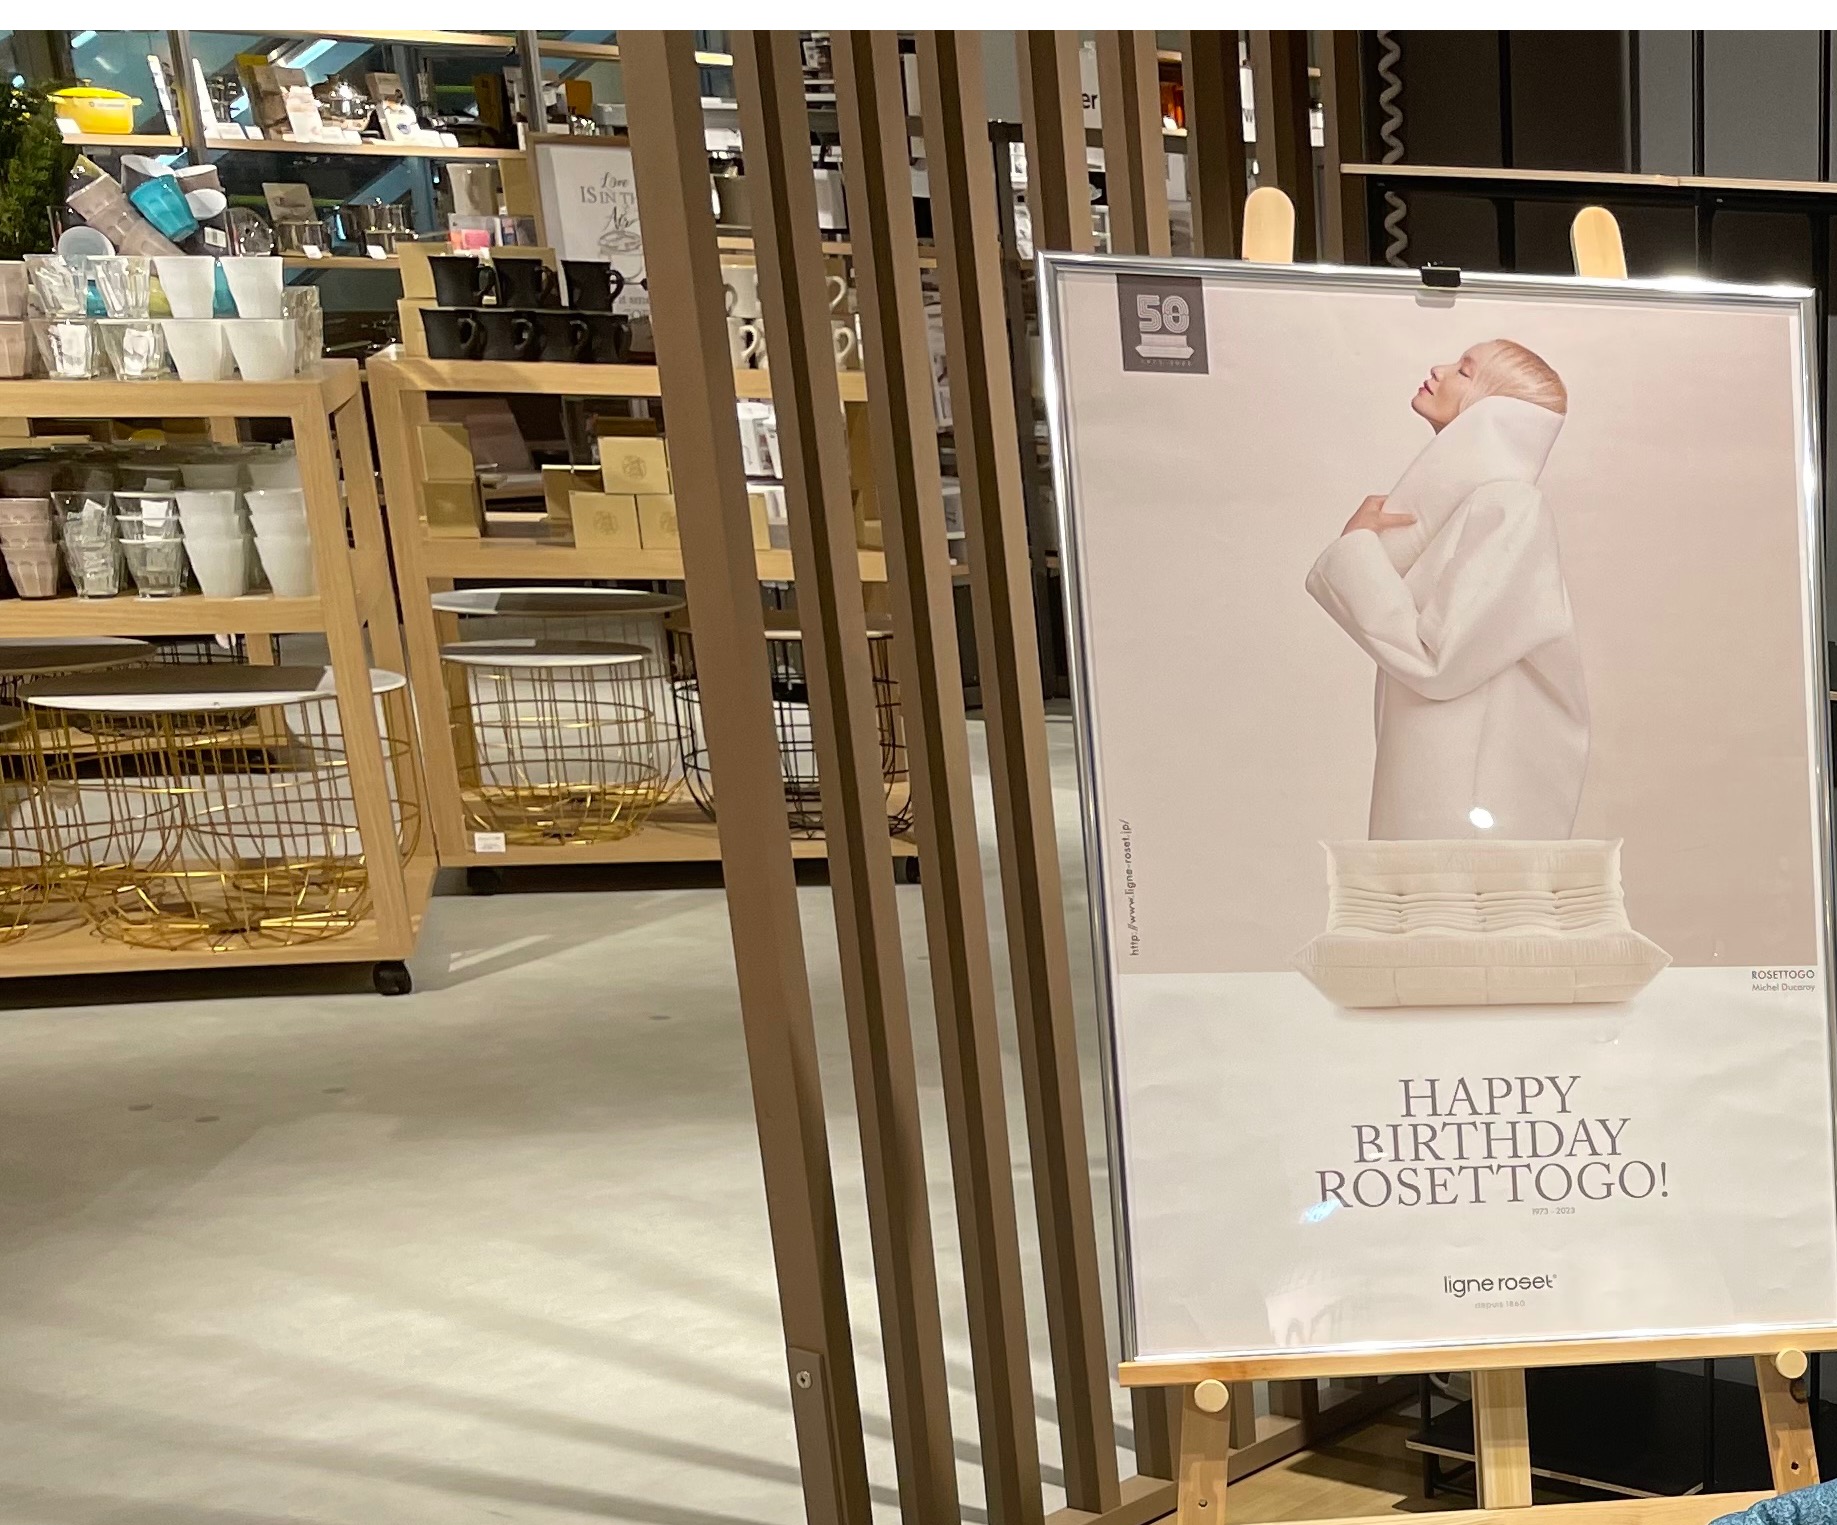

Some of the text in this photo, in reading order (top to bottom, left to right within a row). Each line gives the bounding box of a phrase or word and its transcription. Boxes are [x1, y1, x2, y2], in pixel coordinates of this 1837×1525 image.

[580, 186, 598, 204] IS
[600, 191, 617, 204] IN
[1136, 294, 1190, 333] 50
[1119, 818, 1140, 956] http://www.ligne-roset.jp/
[1751, 969, 1815, 979] ROSETTOGO
[1752, 983, 1816, 992] Michel Ducaroy
[1399, 1075, 1581, 1117] HAPPY
[1351, 1117, 1631, 1163] BIRTHDAY
[1315, 1162, 1670, 1208] ROSETTOGO!
[1444, 1275, 1494, 1298] ligne
[1505, 1300, 1526, 1308] 1860
